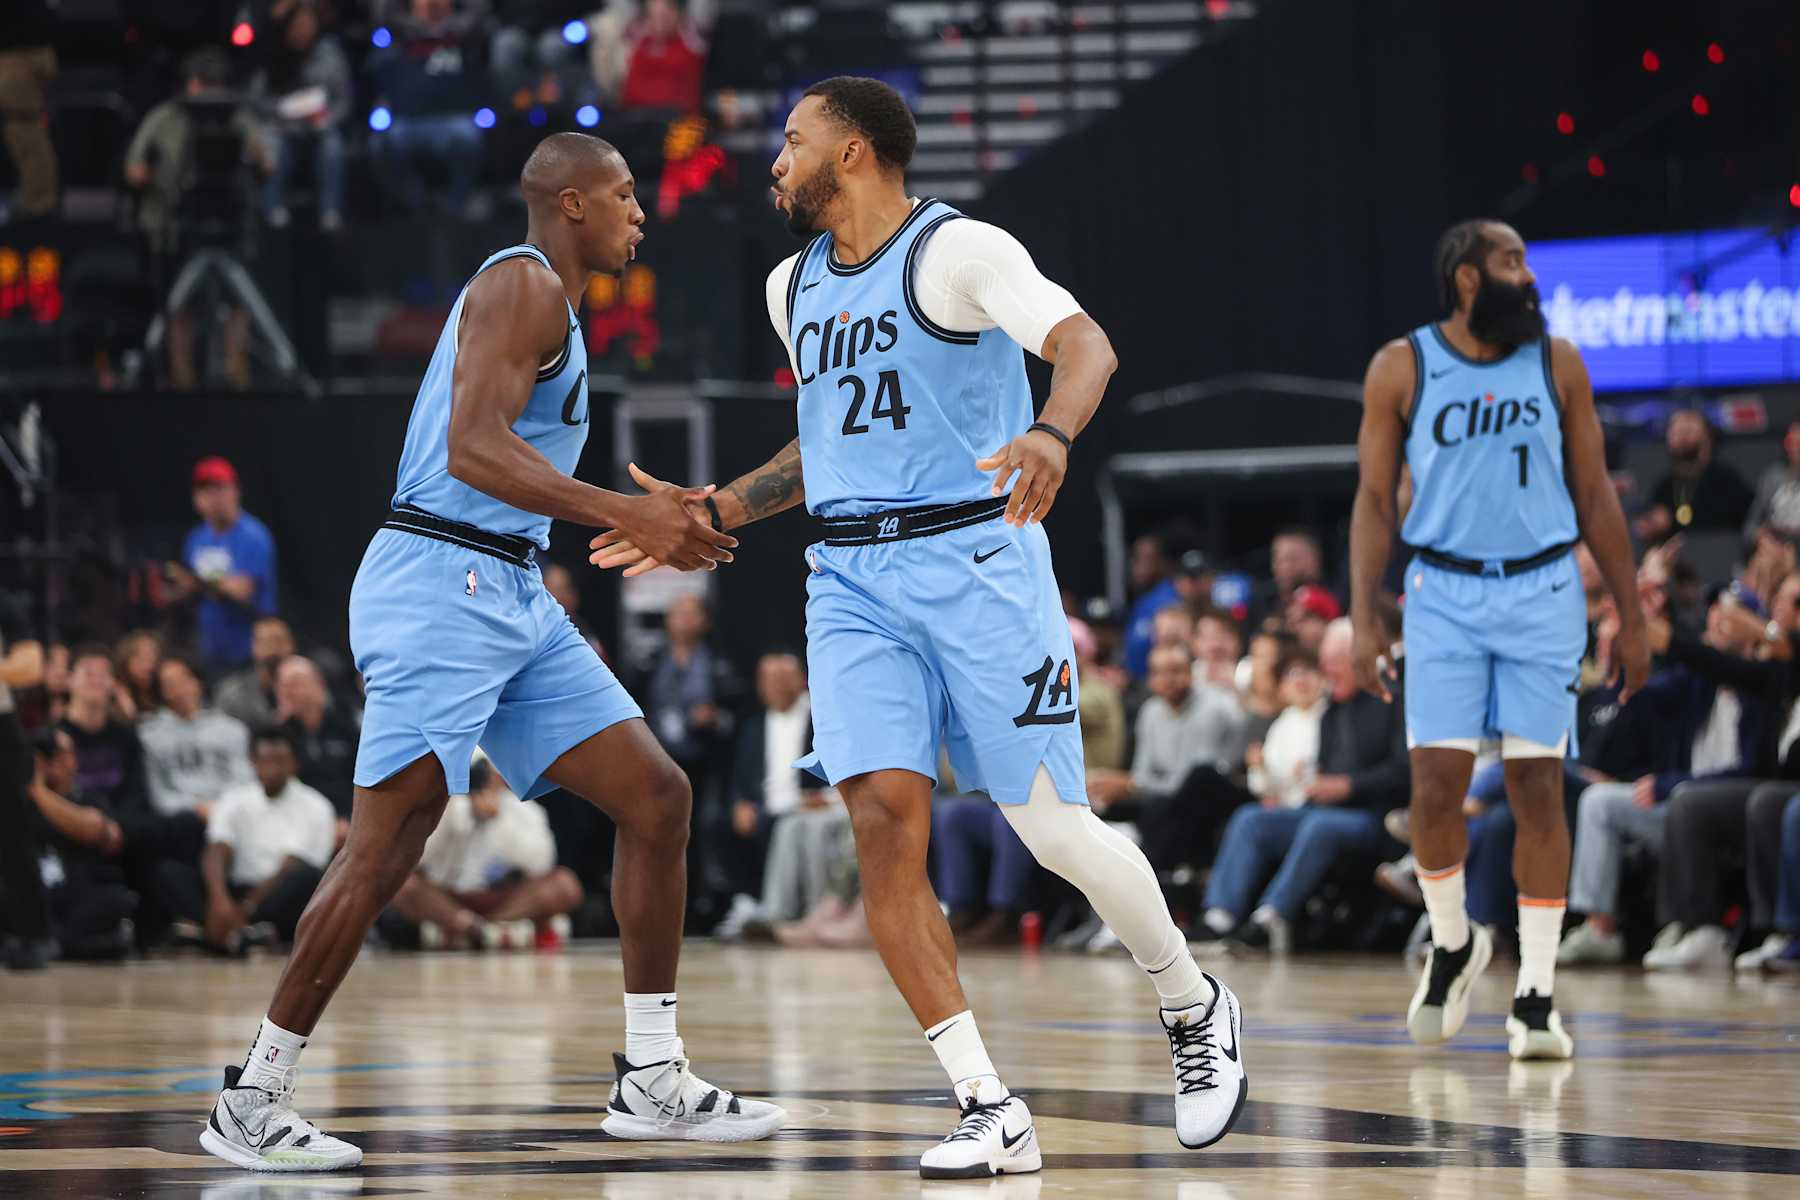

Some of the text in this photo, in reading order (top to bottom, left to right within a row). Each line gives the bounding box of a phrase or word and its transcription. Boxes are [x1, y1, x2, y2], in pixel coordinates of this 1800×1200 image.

[796, 310, 898, 385] Clips
[837, 369, 911, 435] 24
[1432, 393, 1541, 448] Clips
[1511, 444, 1529, 488] 1
[1012, 655, 1077, 728] LA
